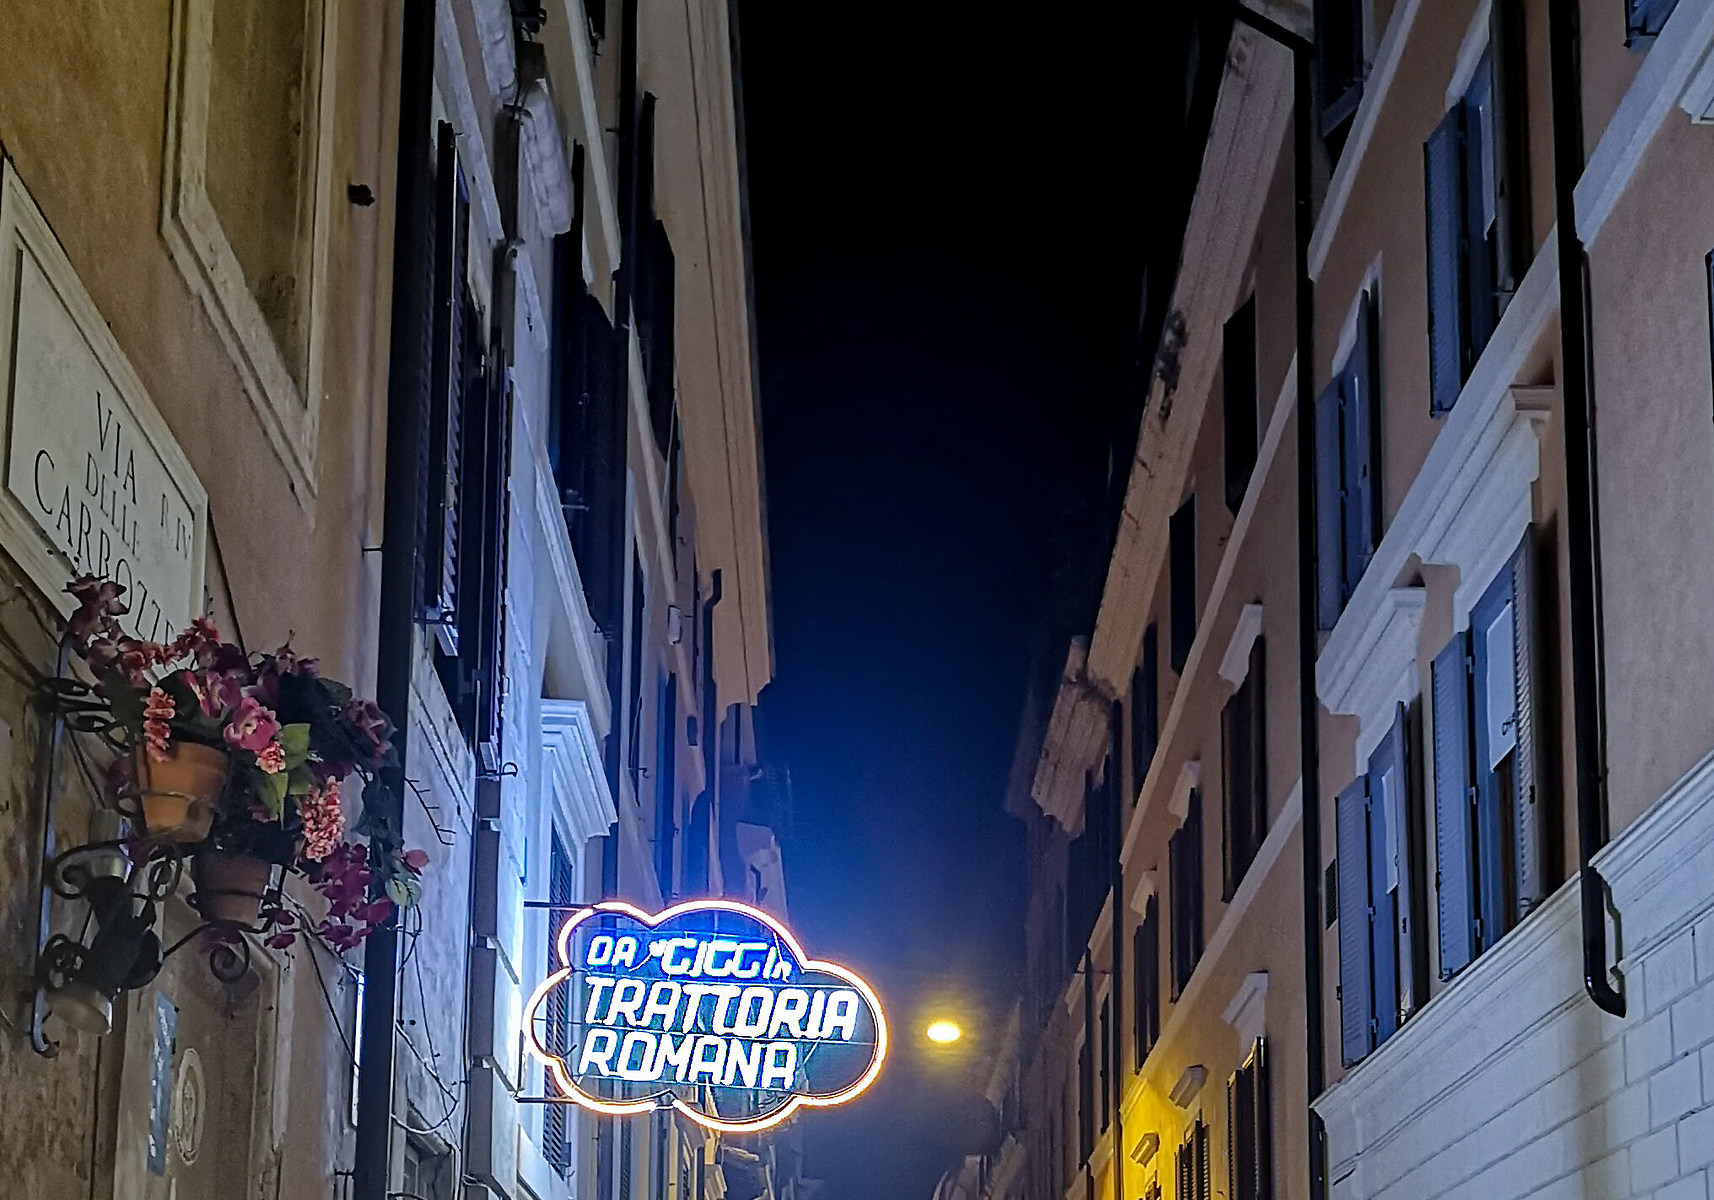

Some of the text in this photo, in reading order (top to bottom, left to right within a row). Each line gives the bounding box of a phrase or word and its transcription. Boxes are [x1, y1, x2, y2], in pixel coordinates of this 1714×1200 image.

[96, 390, 137, 505] VIA
[584, 976, 859, 1041] TRATTORIA
[578, 1029, 799, 1090] ROMANA
